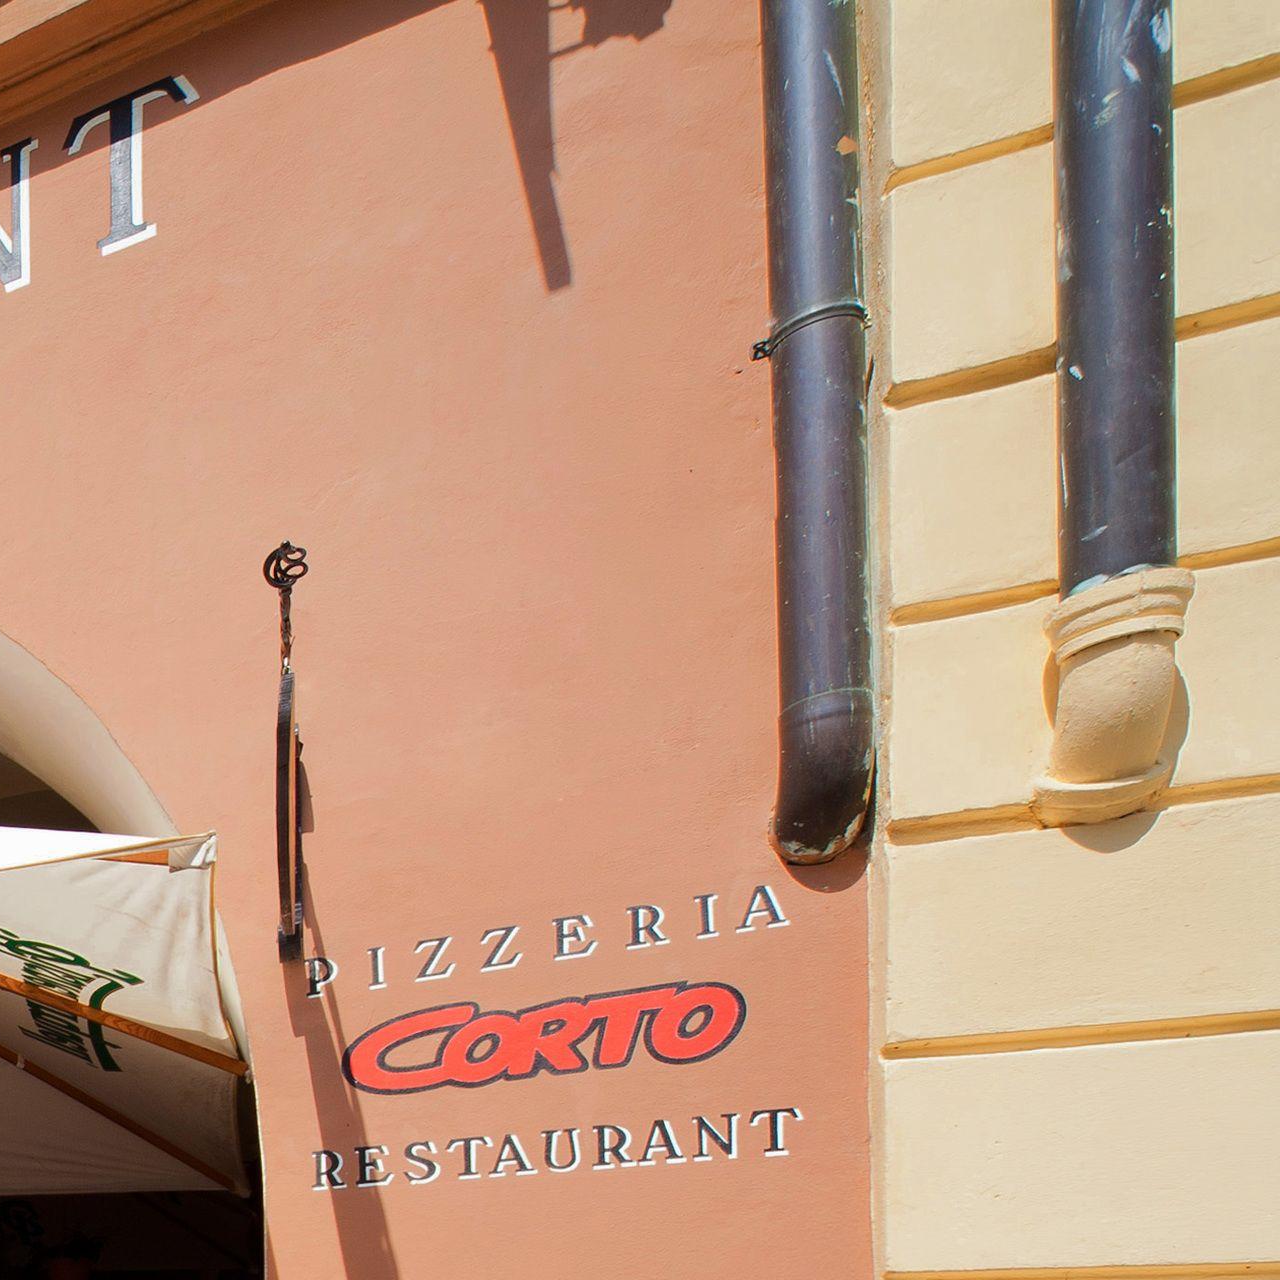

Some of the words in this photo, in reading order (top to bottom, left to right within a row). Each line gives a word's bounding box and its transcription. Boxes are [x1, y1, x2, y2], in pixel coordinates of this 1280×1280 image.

[305, 885, 791, 999] PIZZERIA
[341, 980, 748, 1096] CORTO
[311, 1106, 804, 1191] RESTAURANT
